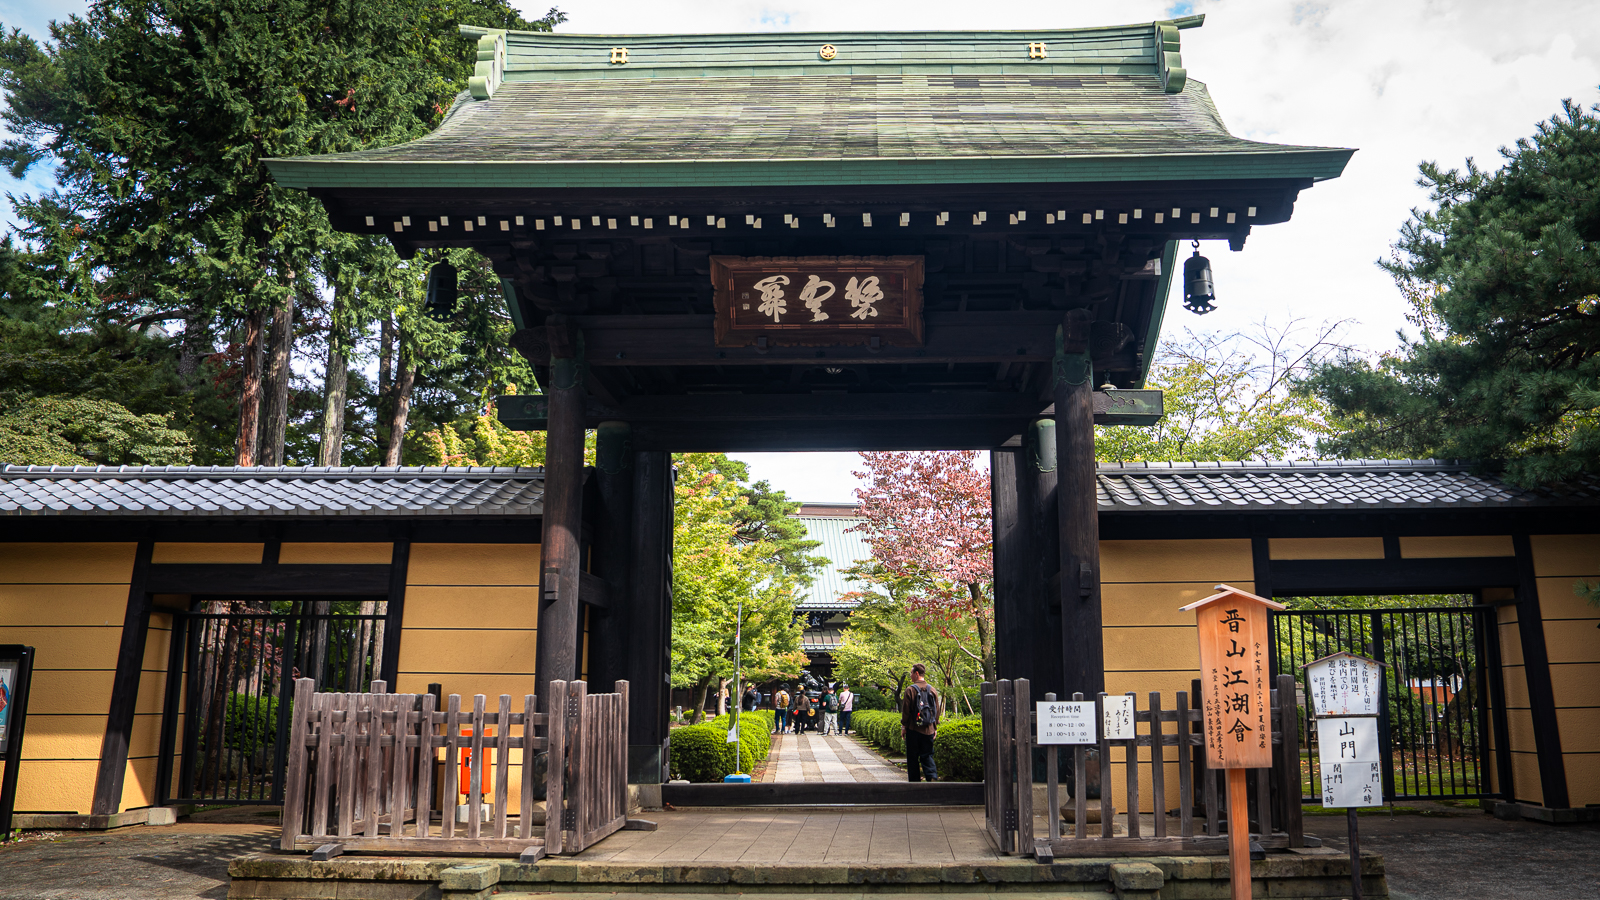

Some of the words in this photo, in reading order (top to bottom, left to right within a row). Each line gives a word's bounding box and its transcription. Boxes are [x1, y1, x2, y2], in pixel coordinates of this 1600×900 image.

[1362, 663, 1371, 711] 文化財を大切に
[1048, 705, 1081, 714] 受付時間
[1339, 721, 1356, 759] 山門
[1324, 774, 1335, 805] 十七時
[1363, 784, 1372, 804] 六時
